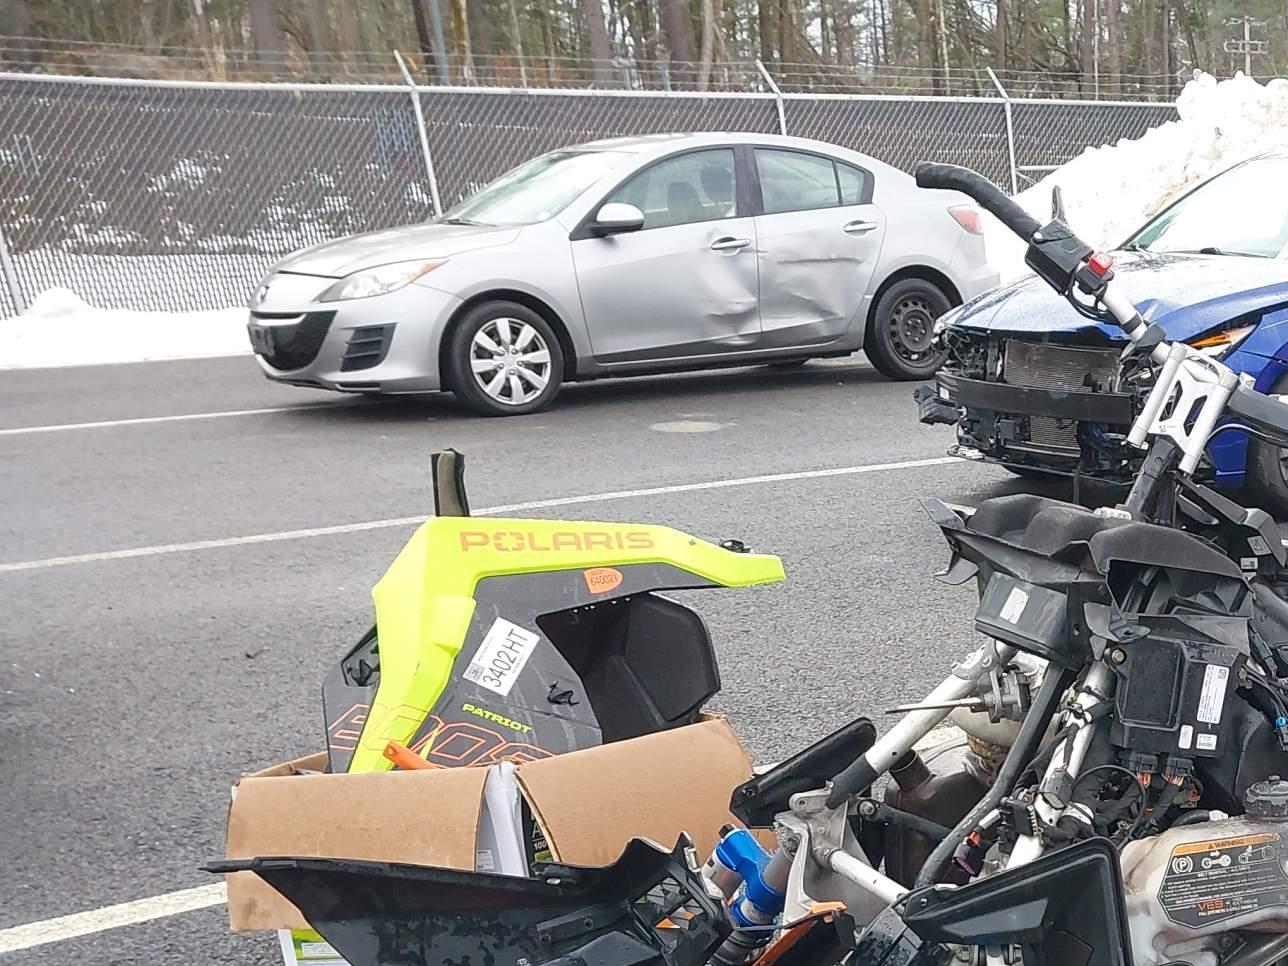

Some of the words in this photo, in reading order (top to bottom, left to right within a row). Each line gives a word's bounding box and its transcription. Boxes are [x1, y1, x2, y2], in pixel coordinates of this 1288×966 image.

[459, 531, 655, 552] POLARIS
[482, 628, 528, 688] 3402HT
[462, 703, 533, 734] PATRIOT
